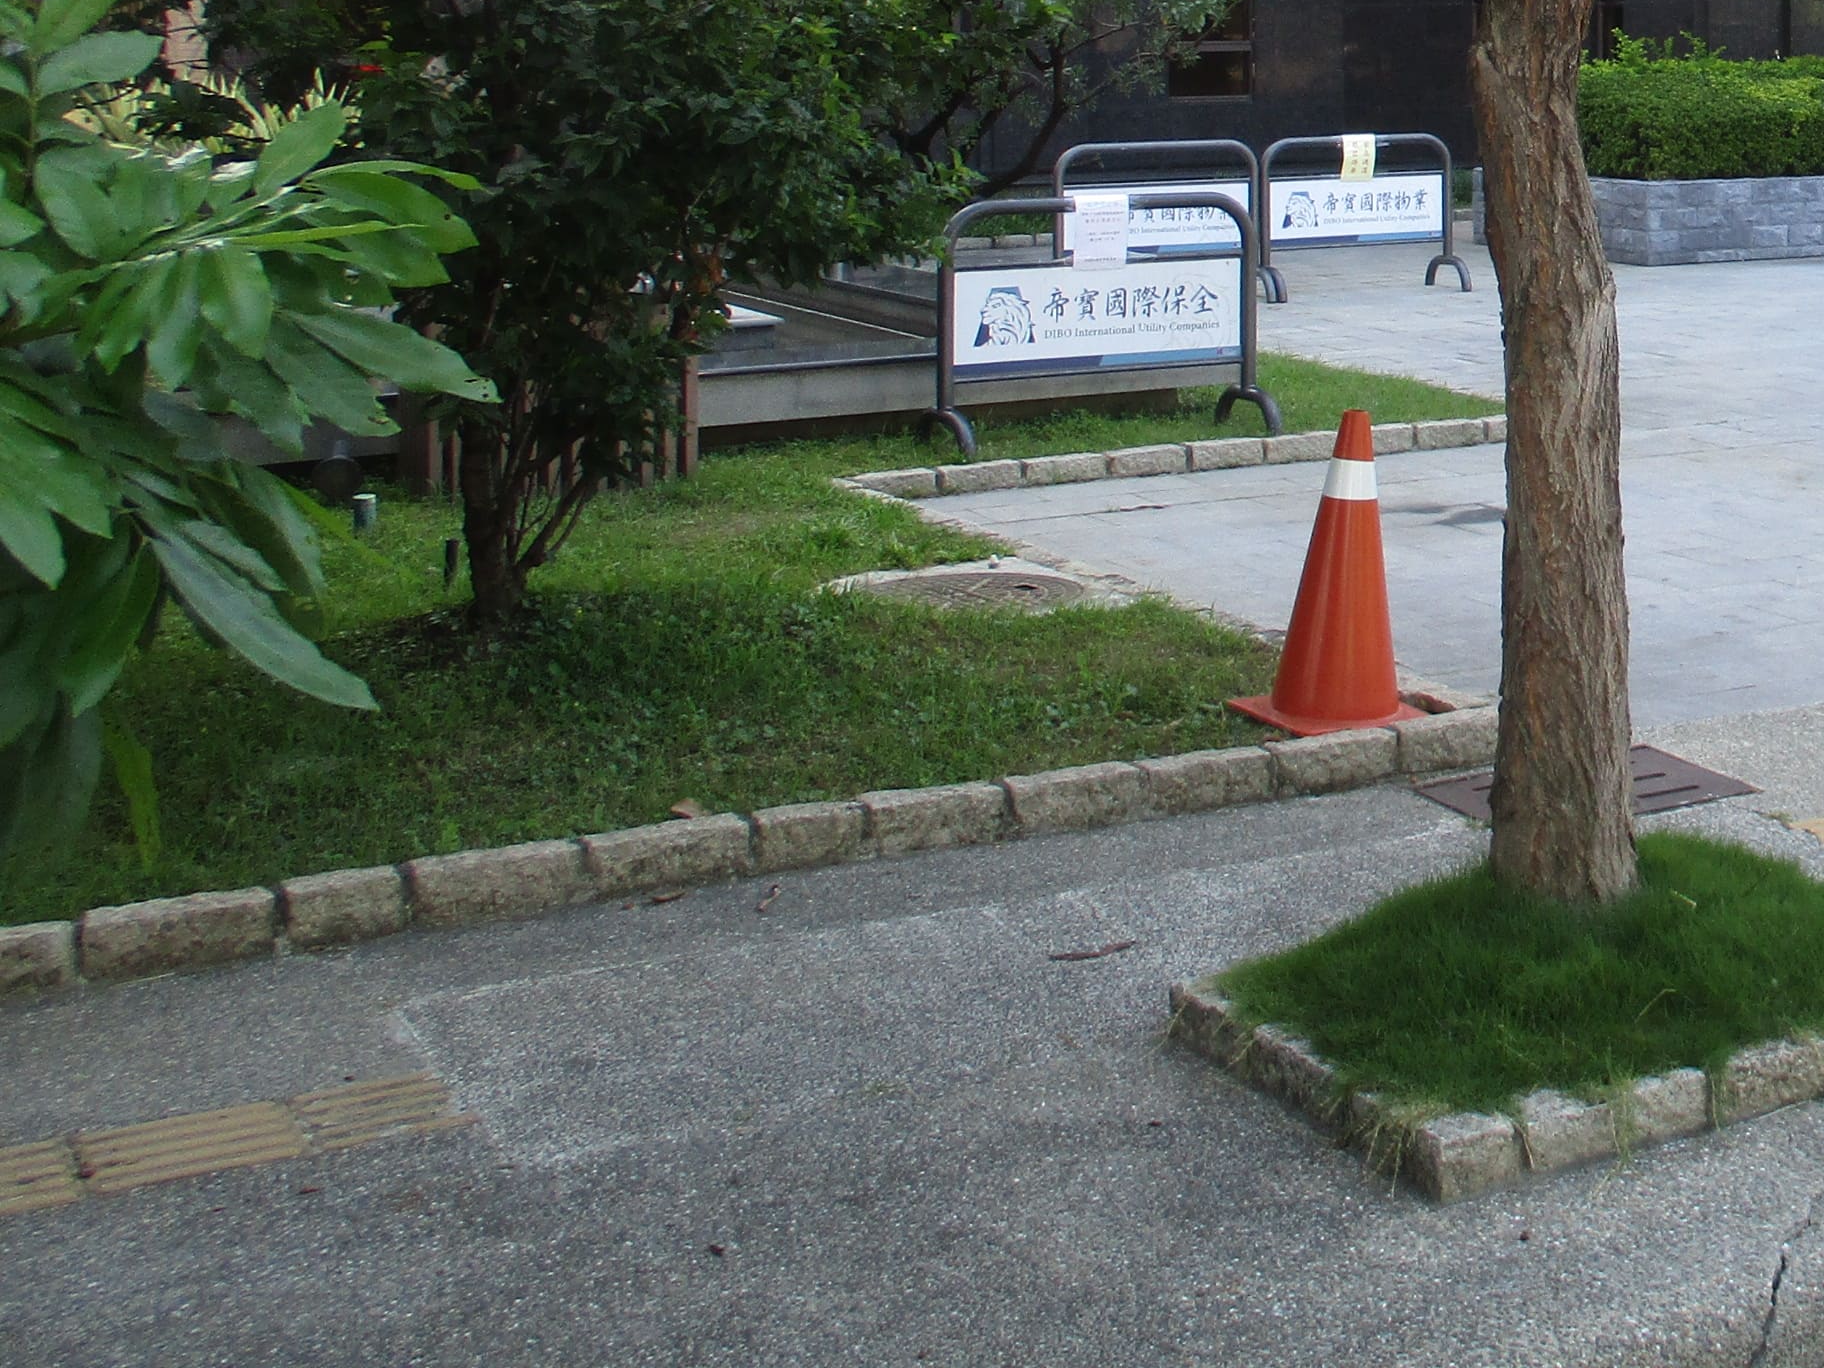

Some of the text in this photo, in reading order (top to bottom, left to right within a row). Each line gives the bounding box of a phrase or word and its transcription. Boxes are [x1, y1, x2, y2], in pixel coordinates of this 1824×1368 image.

[1322, 188, 1428, 214] 帝寶國際物業
[1043, 284, 1219, 324] 帝寶國際保全
[1044, 319, 1220, 339] DIBO International Utility Companies
